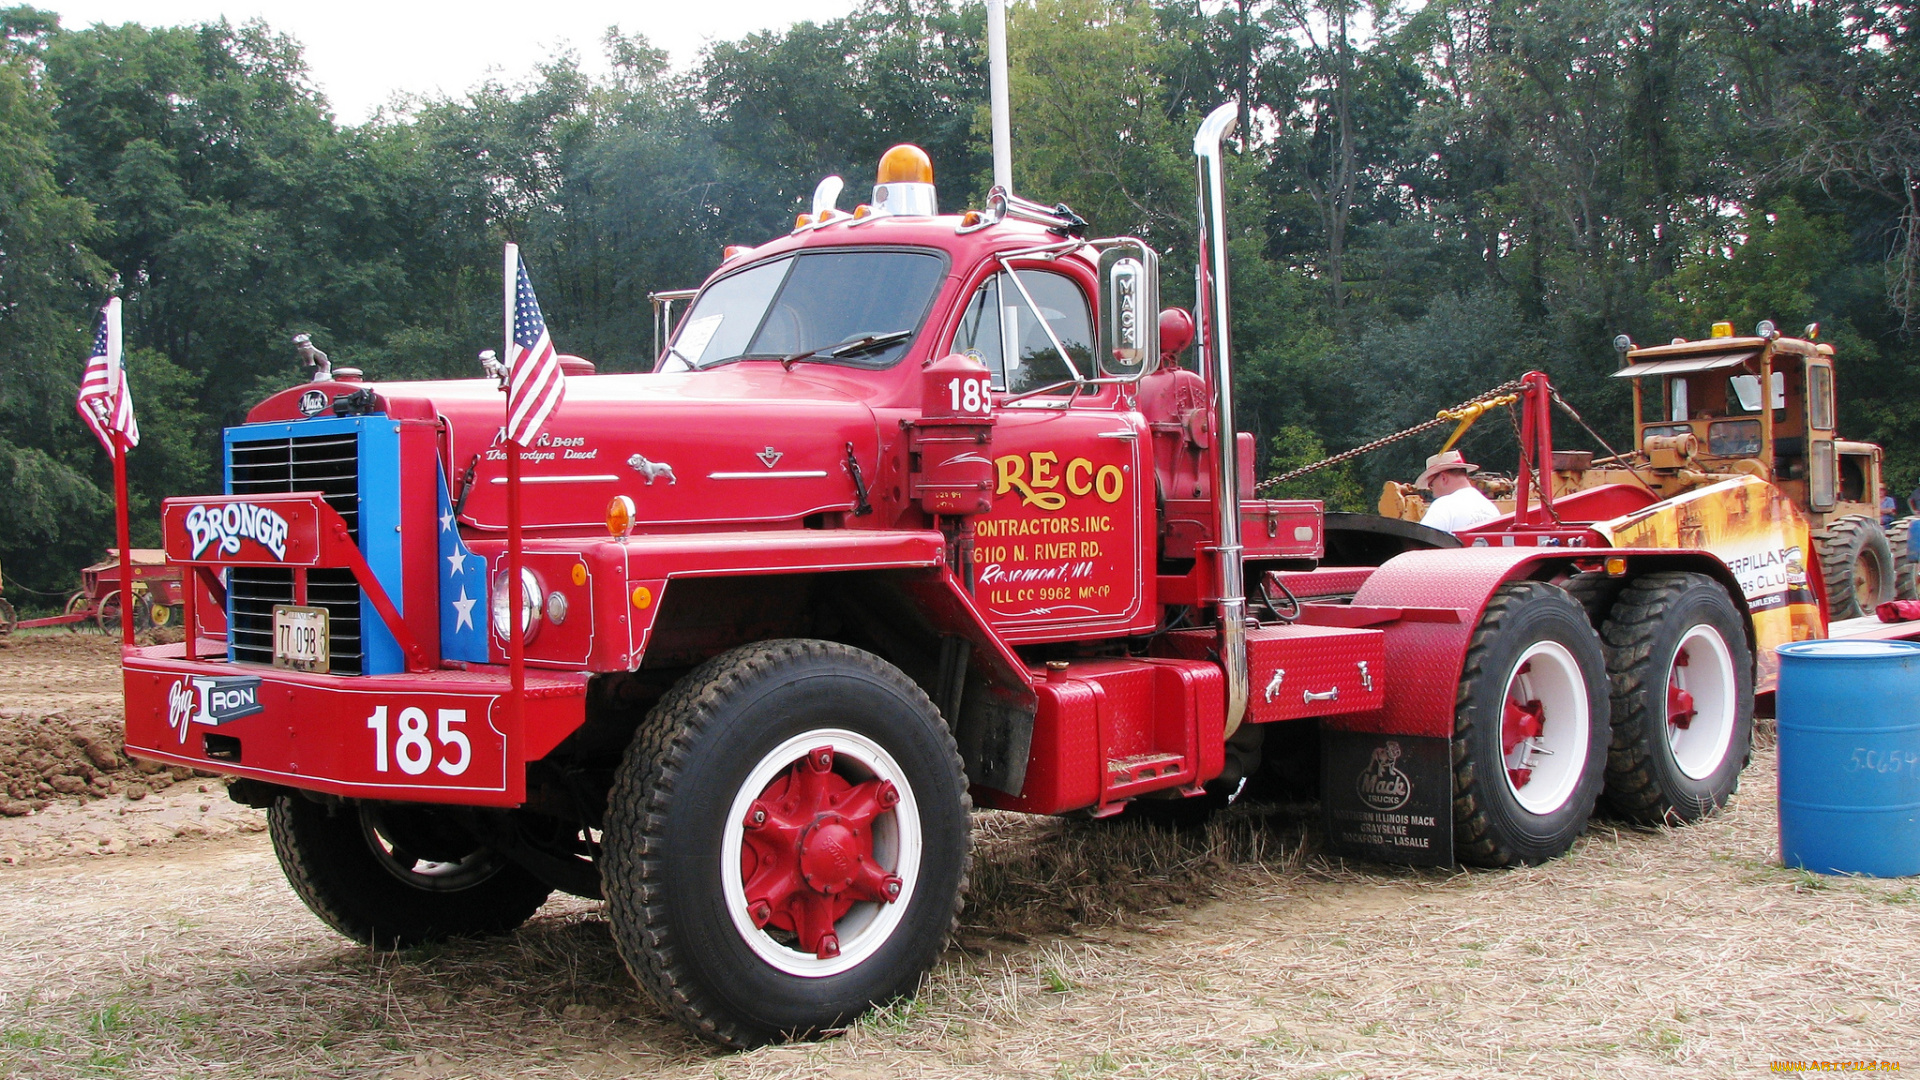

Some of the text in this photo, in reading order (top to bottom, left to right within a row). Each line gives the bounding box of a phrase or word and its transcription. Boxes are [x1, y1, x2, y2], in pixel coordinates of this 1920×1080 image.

[1120, 279, 1135, 344] MACK
[948, 378, 991, 414] 185
[186, 502, 289, 561] BRONGE
[973, 541, 1103, 563] 6110 N. RIVER RD.
[1757, 573, 1786, 589] CLU
[991, 589, 1014, 604] ILL
[1040, 586, 1071, 600] 9962
[280, 625, 316, 654] 77 098
[169, 675, 197, 744] Big
[367, 705, 472, 776] 185
[1362, 775, 1406, 795] Mack
[1368, 796, 1400, 804] TRUCKS
[1361, 823, 1406, 835] GRAYSLAKE
[1375, 813, 1409, 825] ILLINOIS
[1411, 816, 1435, 827] MACK
[1394, 836, 1429, 848] LASALLE
